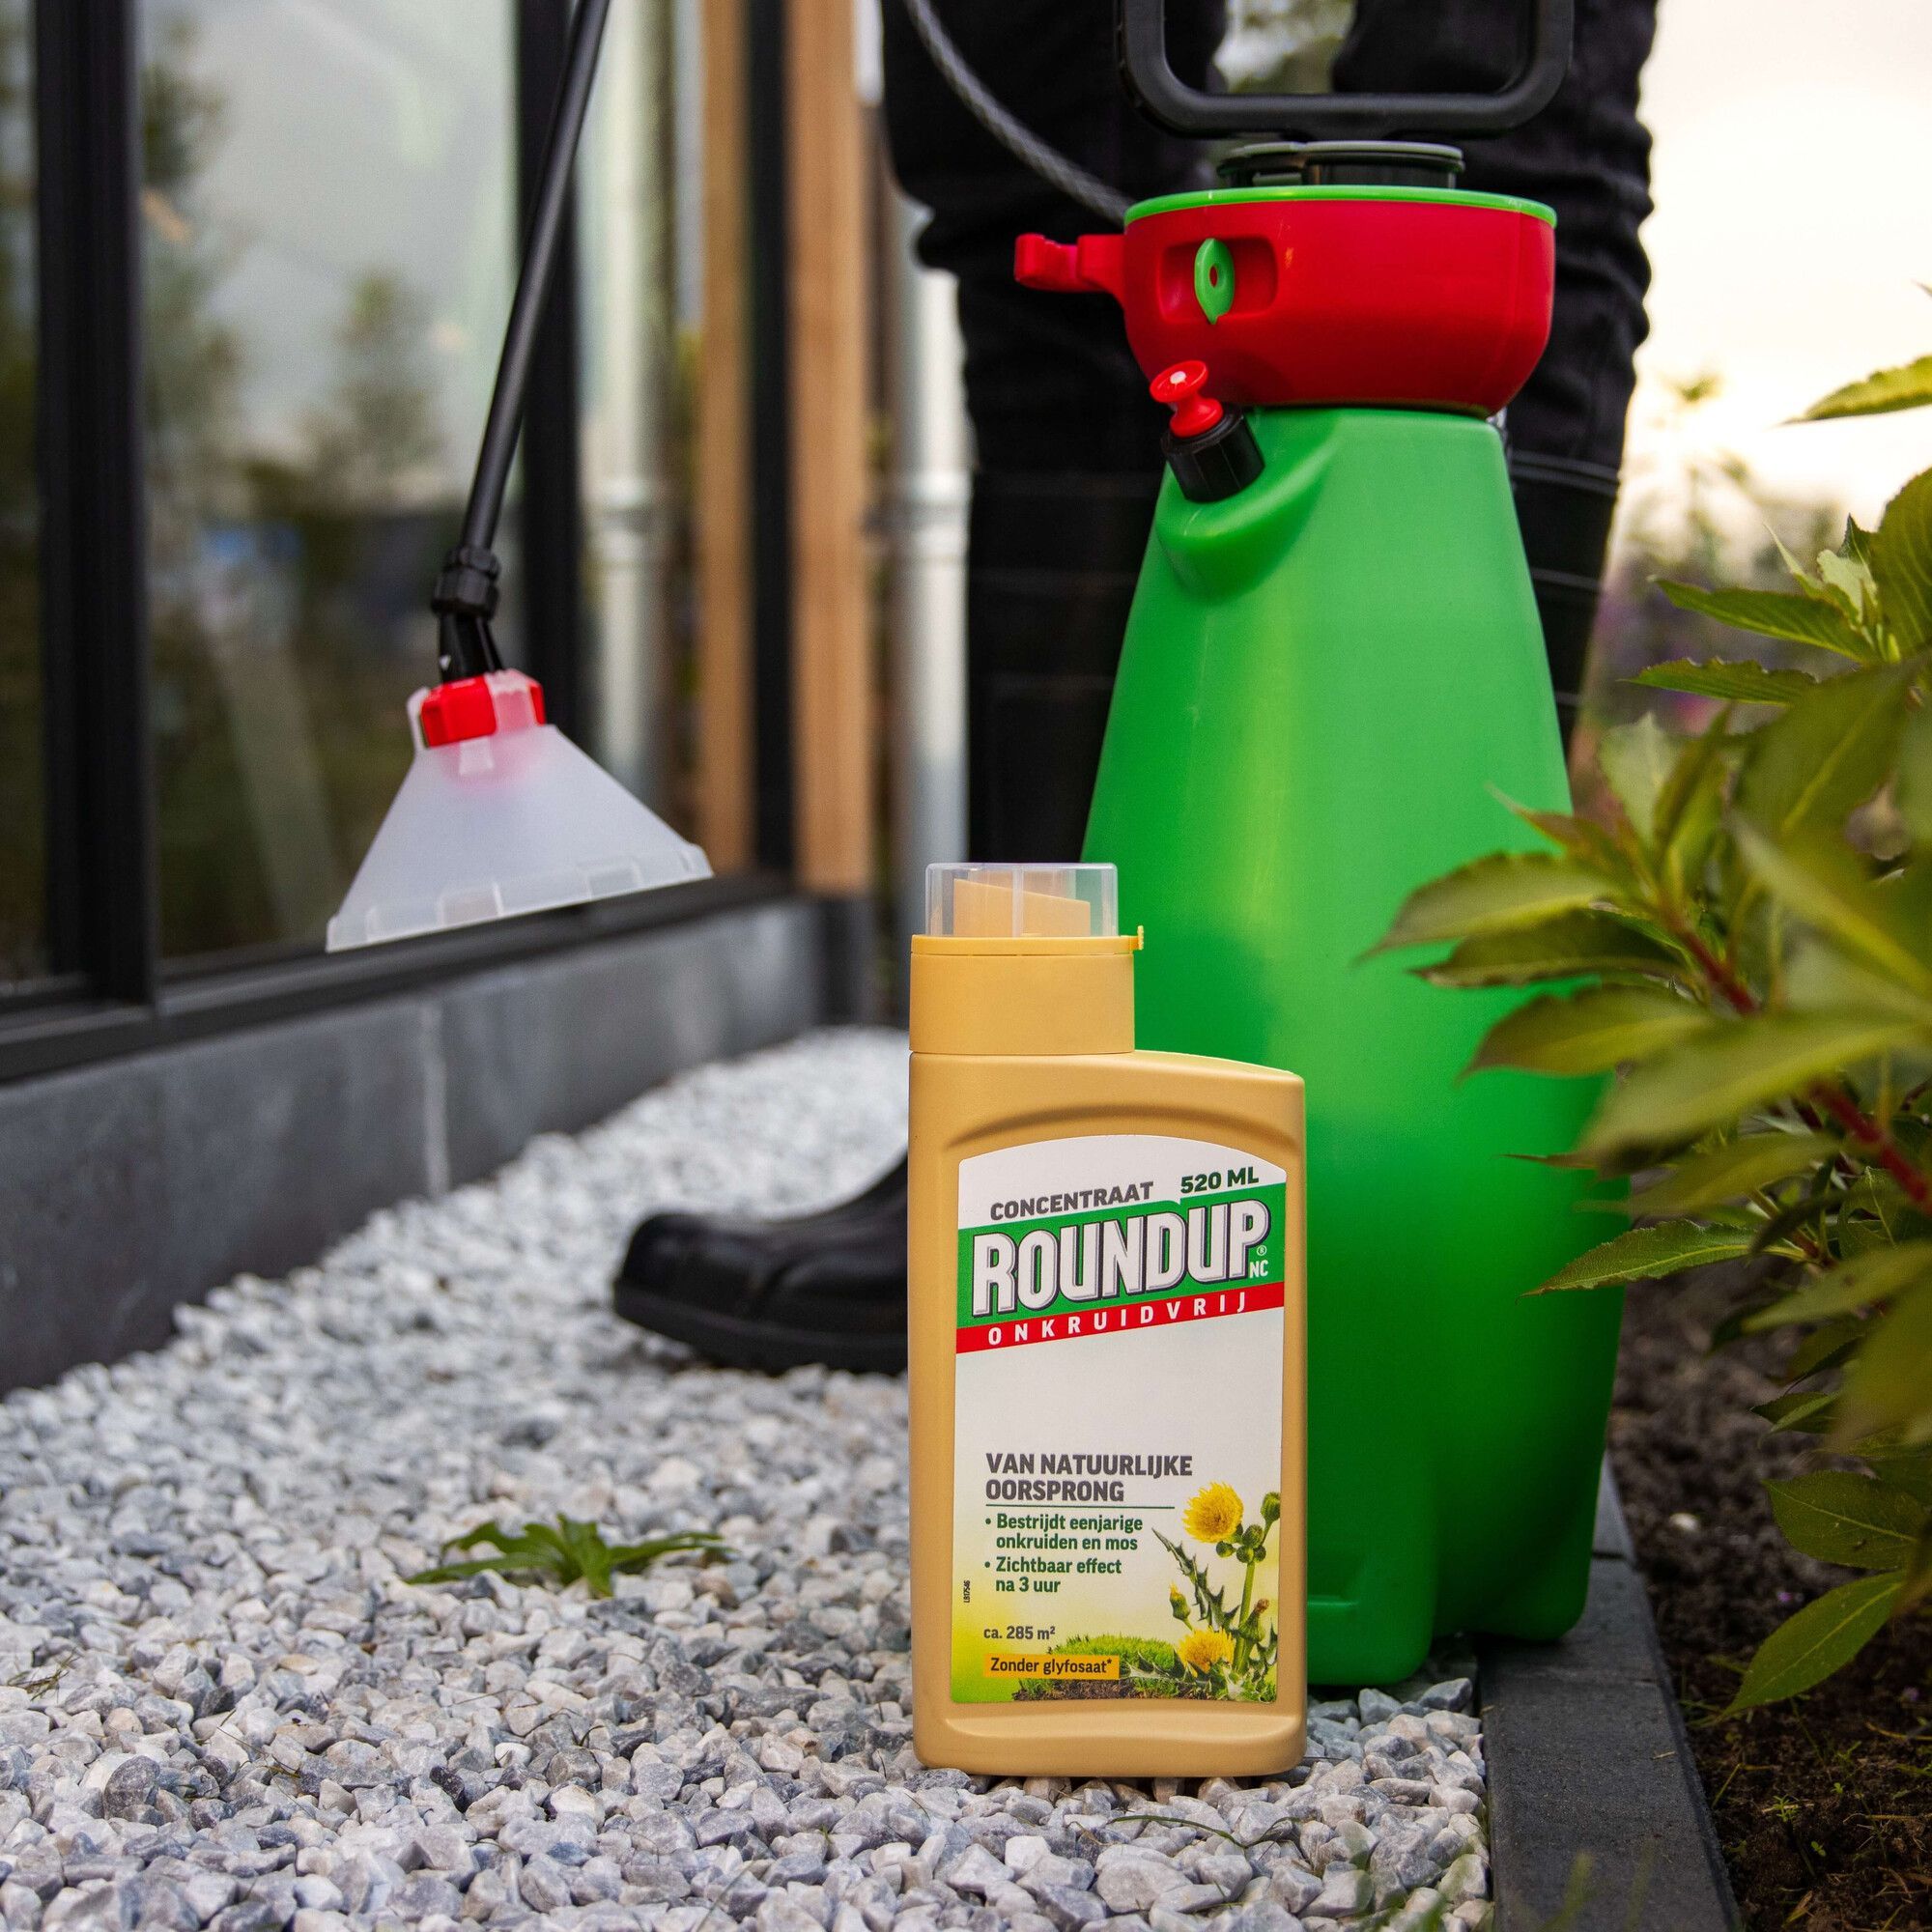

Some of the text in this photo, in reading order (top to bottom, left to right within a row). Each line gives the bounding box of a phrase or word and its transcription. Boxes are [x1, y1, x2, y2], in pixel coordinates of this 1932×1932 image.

[1180, 1166, 1260, 1194] 520 ML
[990, 1180, 1153, 1221] CONCENTRAAT
[971, 1199, 1271, 1318] ROUNDUP
[1249, 1260, 1269, 1279] NC
[988, 1292, 1247, 1347] ONKRUIDVRIJ
[985, 1453, 1193, 1479] VAN NATUURLIJKE
[985, 1479, 1124, 1502] OORSPRONG
[996, 1513, 1143, 1534] Bestrijdt eenjarige
[996, 1533, 1138, 1550] onkruiden en mos
[995, 1556, 1122, 1575] Zichtbaar effect
[995, 1577, 1061, 1593] na 3 uur
[983, 1627, 1003, 1639] ca.
[1007, 1626, 1034, 1639] 285
[990, 1658, 1038, 1672] Zonder
